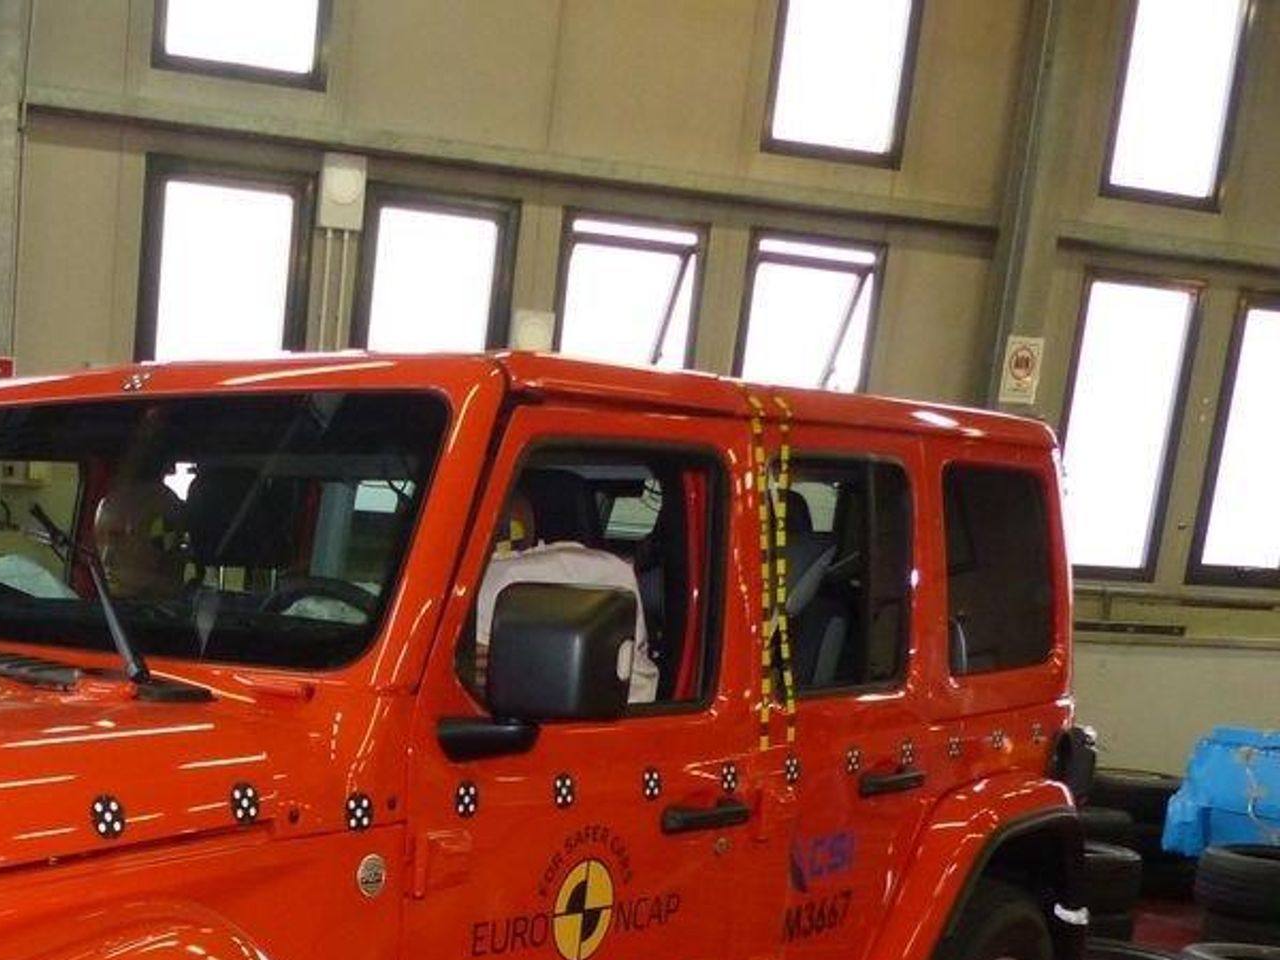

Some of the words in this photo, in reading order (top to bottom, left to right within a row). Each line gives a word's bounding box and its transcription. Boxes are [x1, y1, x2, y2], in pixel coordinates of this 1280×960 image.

[564, 823, 609, 854] SAFER
[810, 830, 856, 877] CSI
[472, 912, 550, 957] EURO
[615, 892, 680, 931] NCAP
[781, 888, 852, 943] M3667
